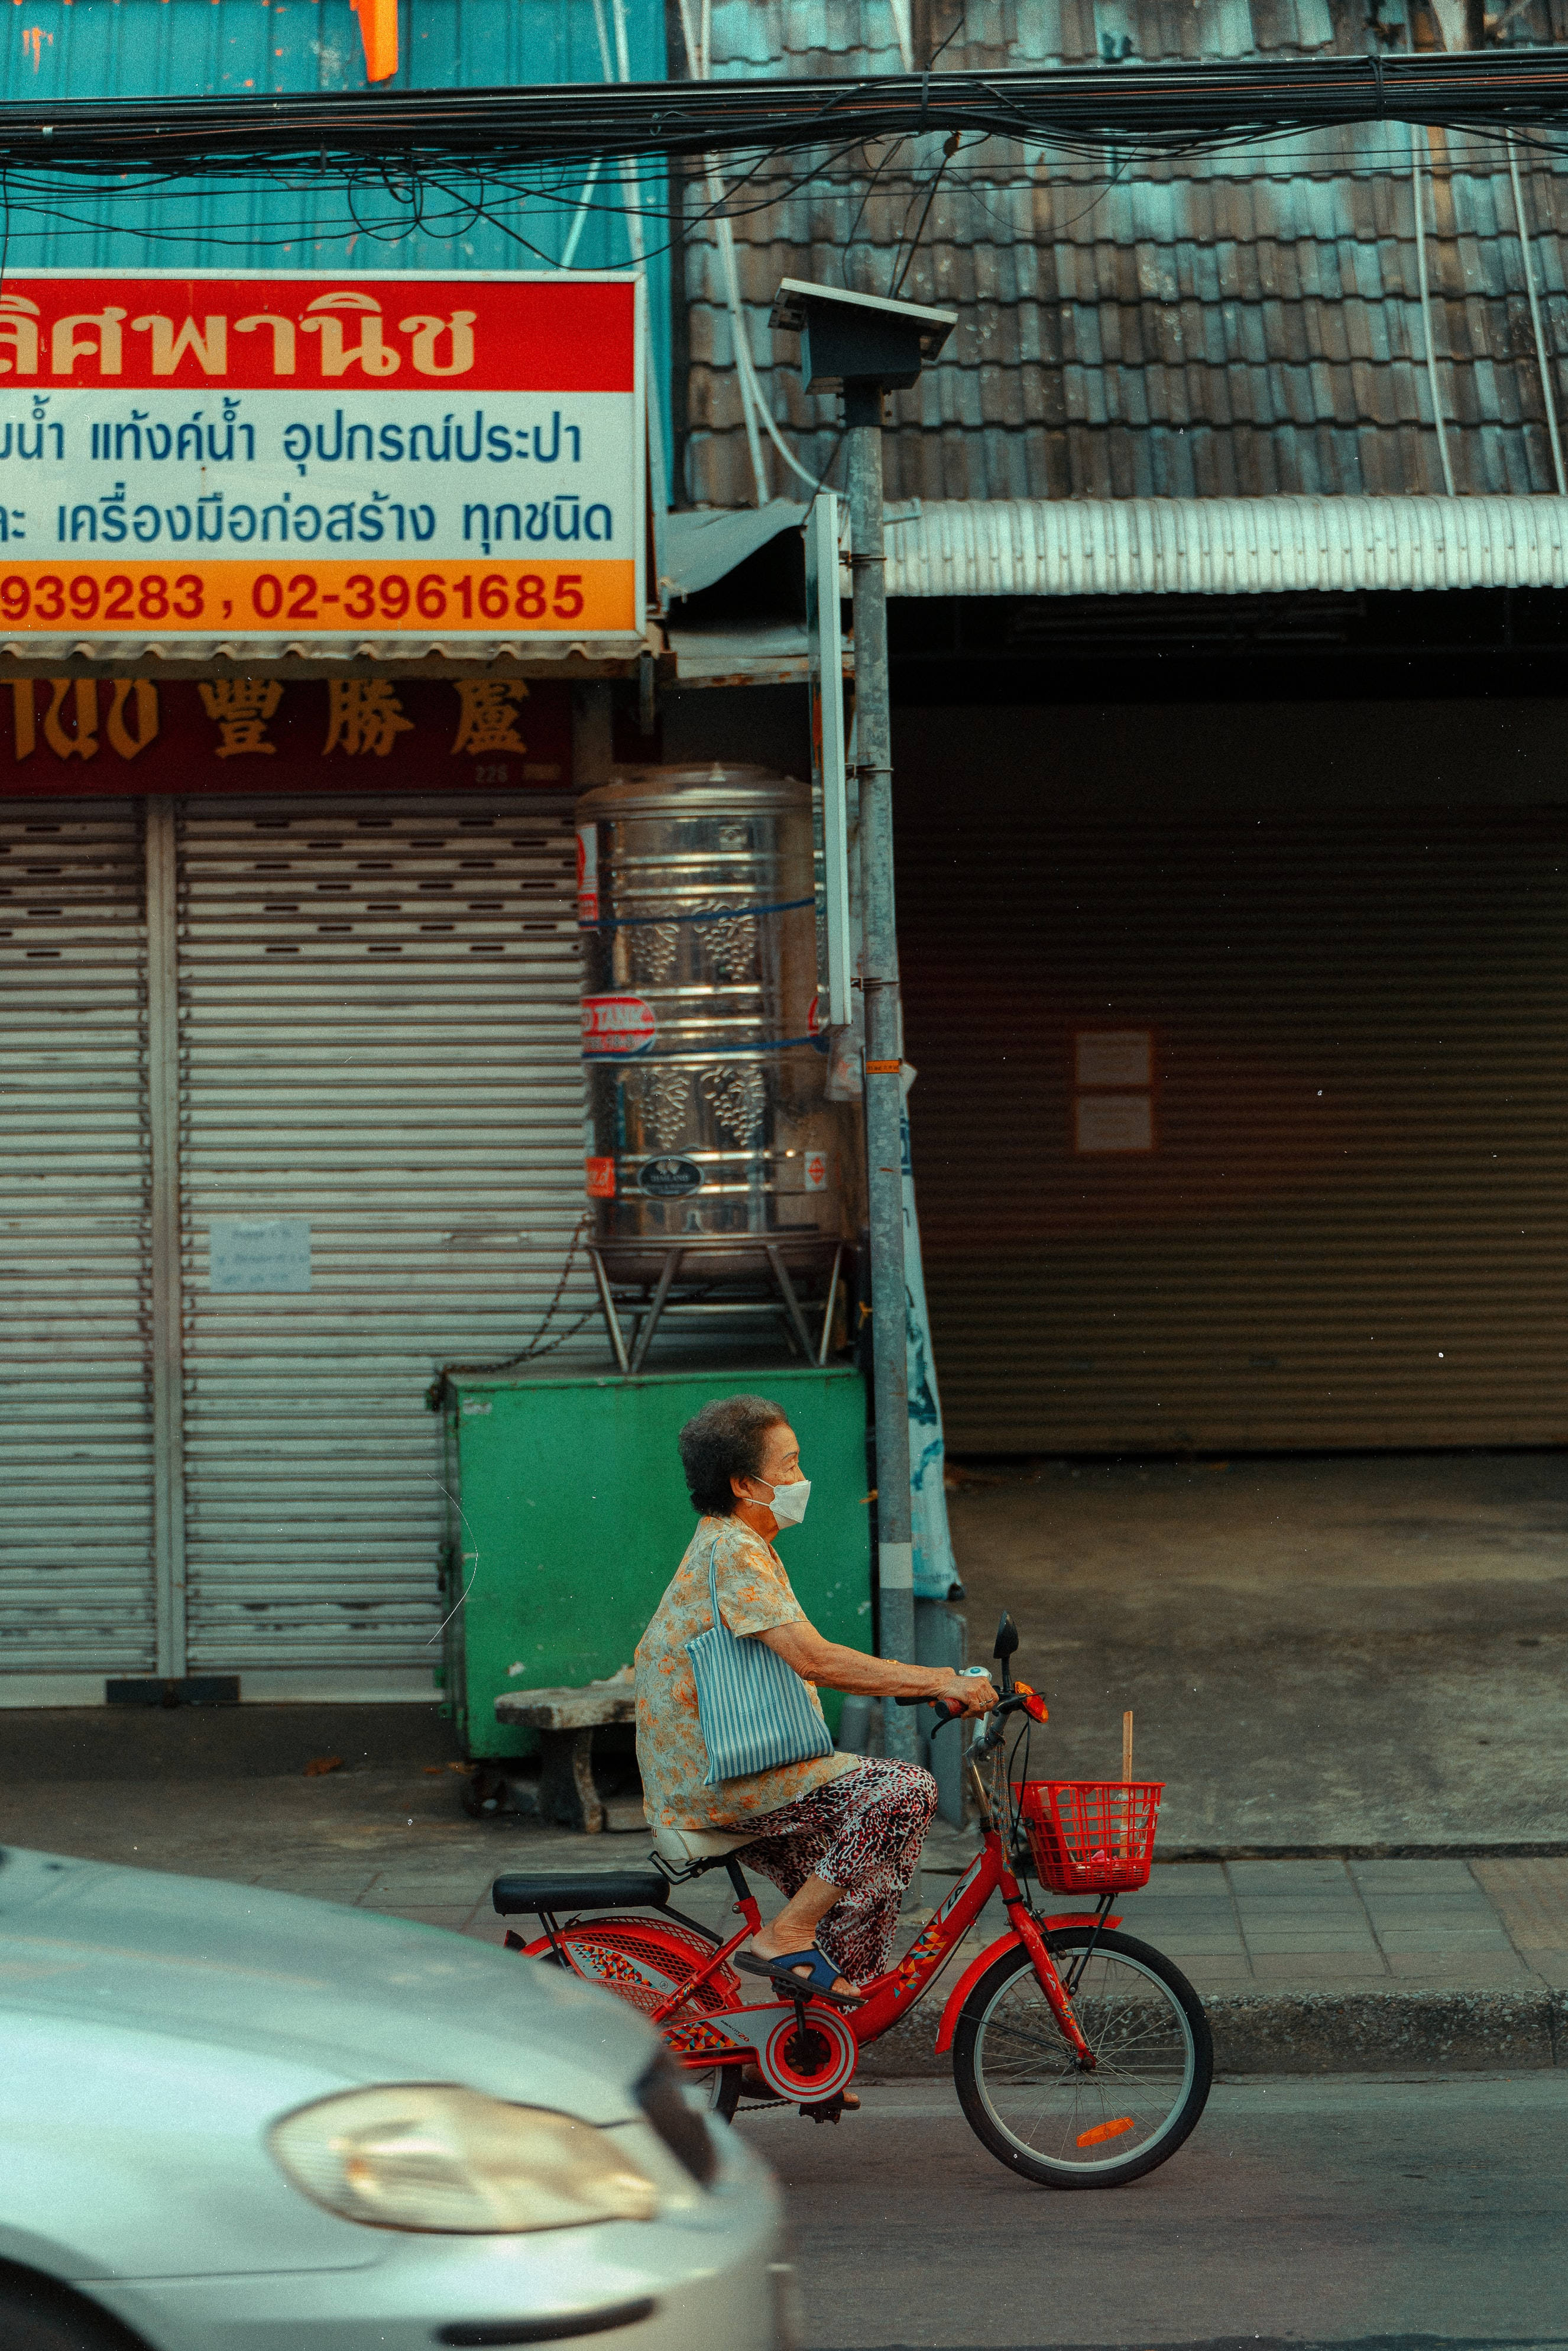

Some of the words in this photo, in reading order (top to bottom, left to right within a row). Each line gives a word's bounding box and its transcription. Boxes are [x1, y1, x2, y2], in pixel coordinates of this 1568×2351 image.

[283, 409, 582, 477] อุปกรณ์ประปา
[464, 495, 613, 555] ทุกชนิด
[251, 574, 584, 620] 02-3961685
[947, 1883, 967, 1912] LA
